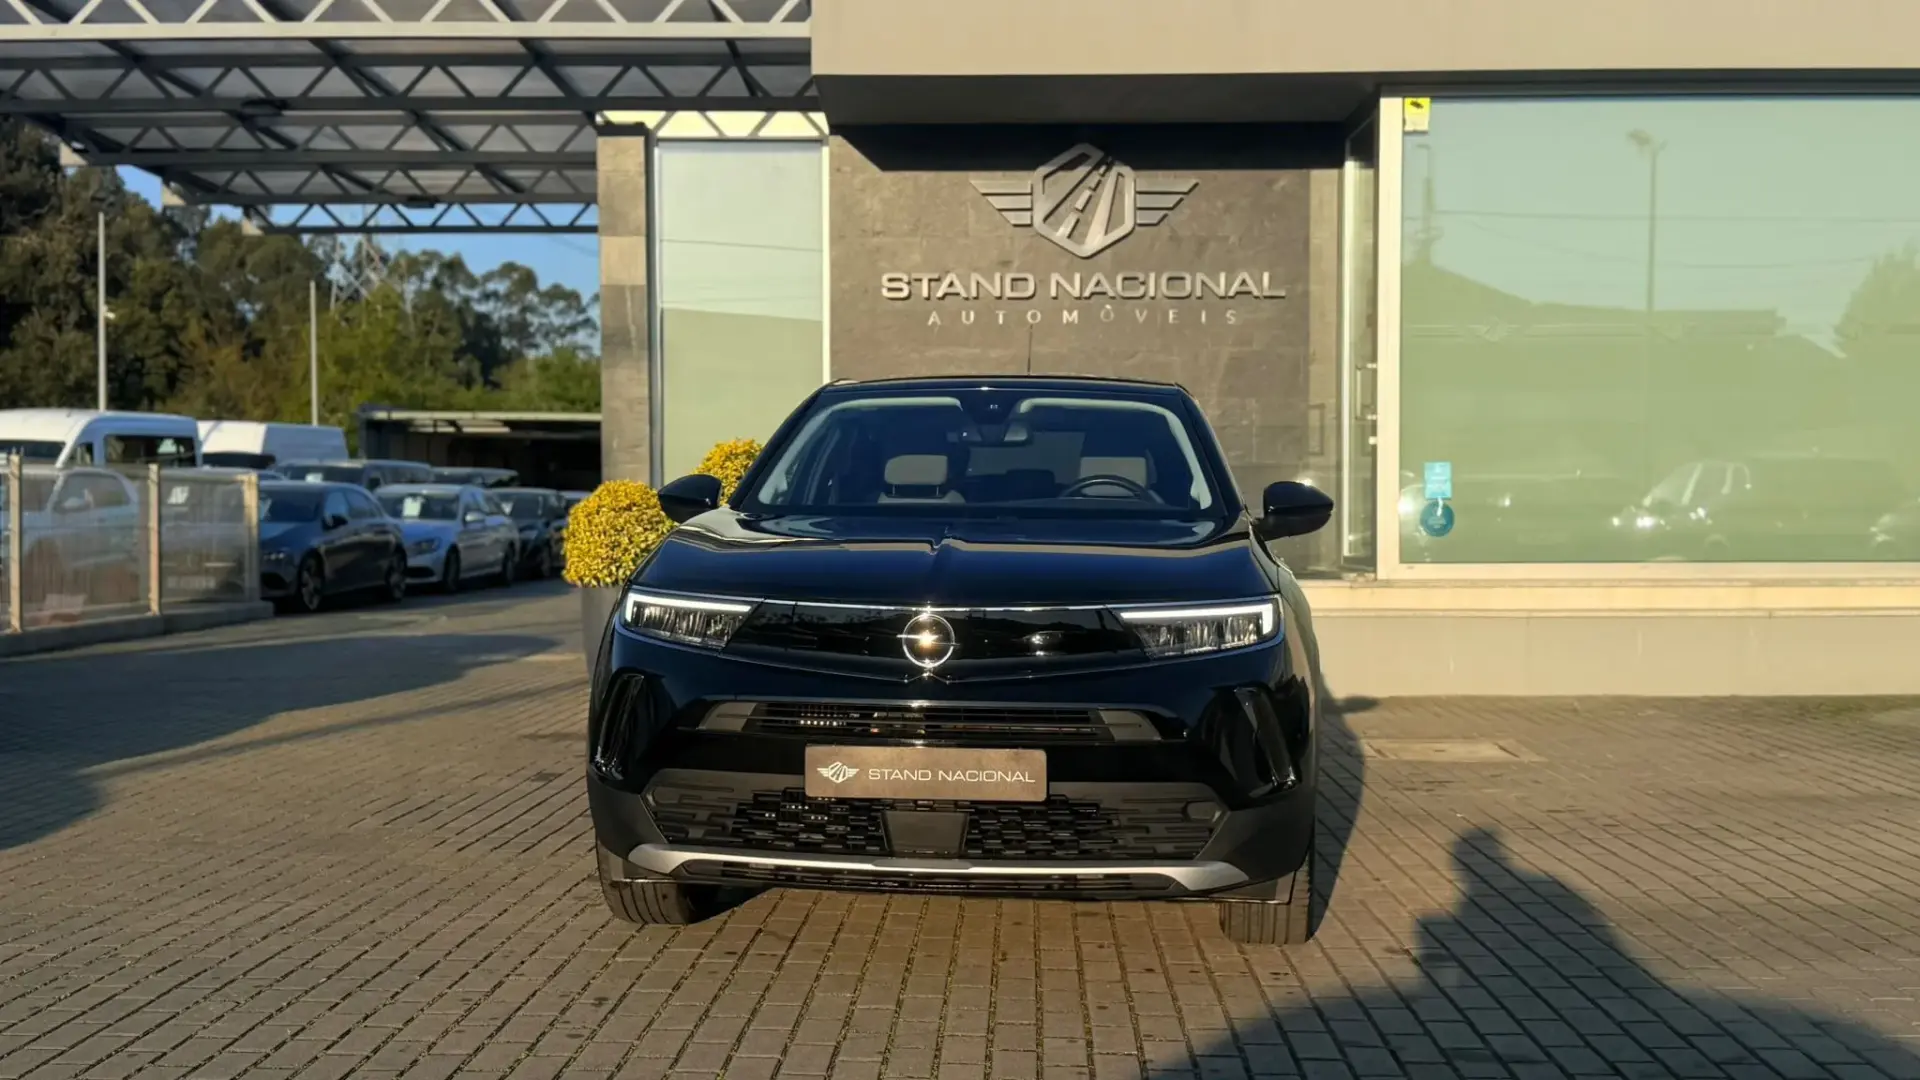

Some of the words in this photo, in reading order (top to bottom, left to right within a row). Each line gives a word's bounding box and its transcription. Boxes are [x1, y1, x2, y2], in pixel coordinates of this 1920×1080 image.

[881, 272, 1036, 300] STAND
[1049, 271, 1286, 299] NACIONAL
[868, 768, 932, 781] STAND
[938, 770, 1036, 783] NACIONAL
